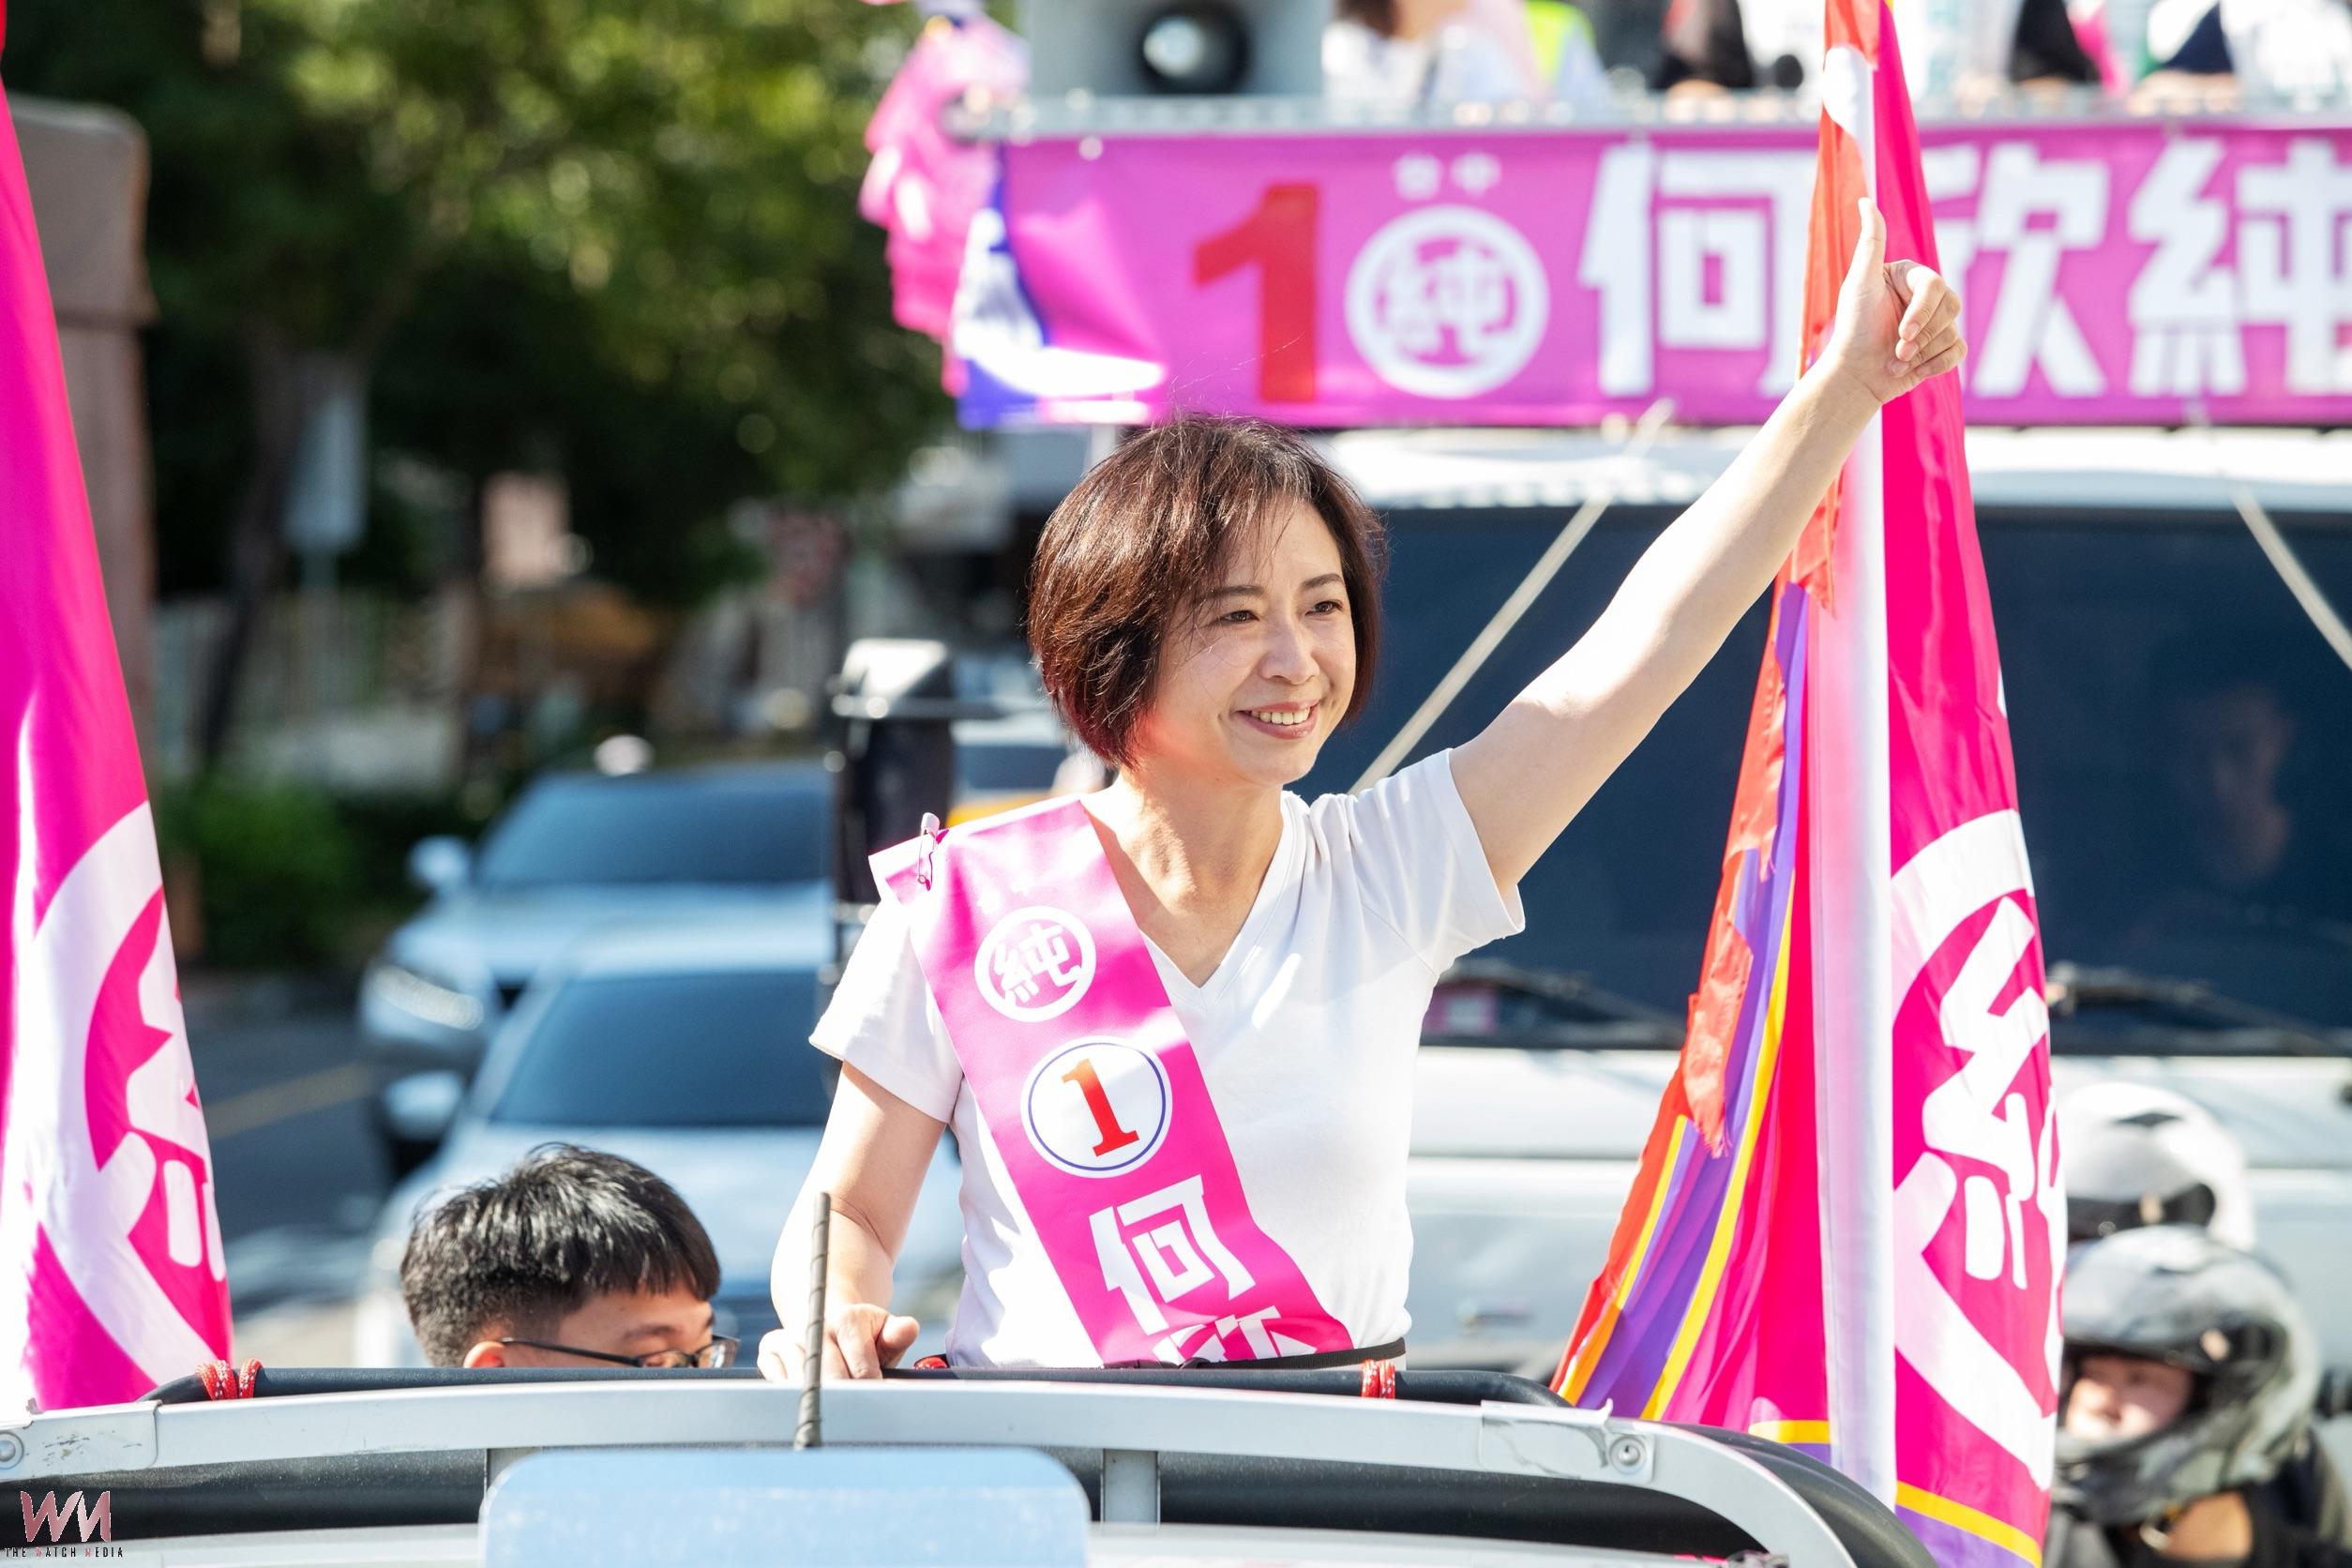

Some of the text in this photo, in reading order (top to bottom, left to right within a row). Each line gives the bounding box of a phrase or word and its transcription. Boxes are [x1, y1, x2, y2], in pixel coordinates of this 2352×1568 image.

[1193, 182, 1317, 403] 1
[993, 923, 1082, 1003] 純
[1061, 1057, 1139, 1157] 1
